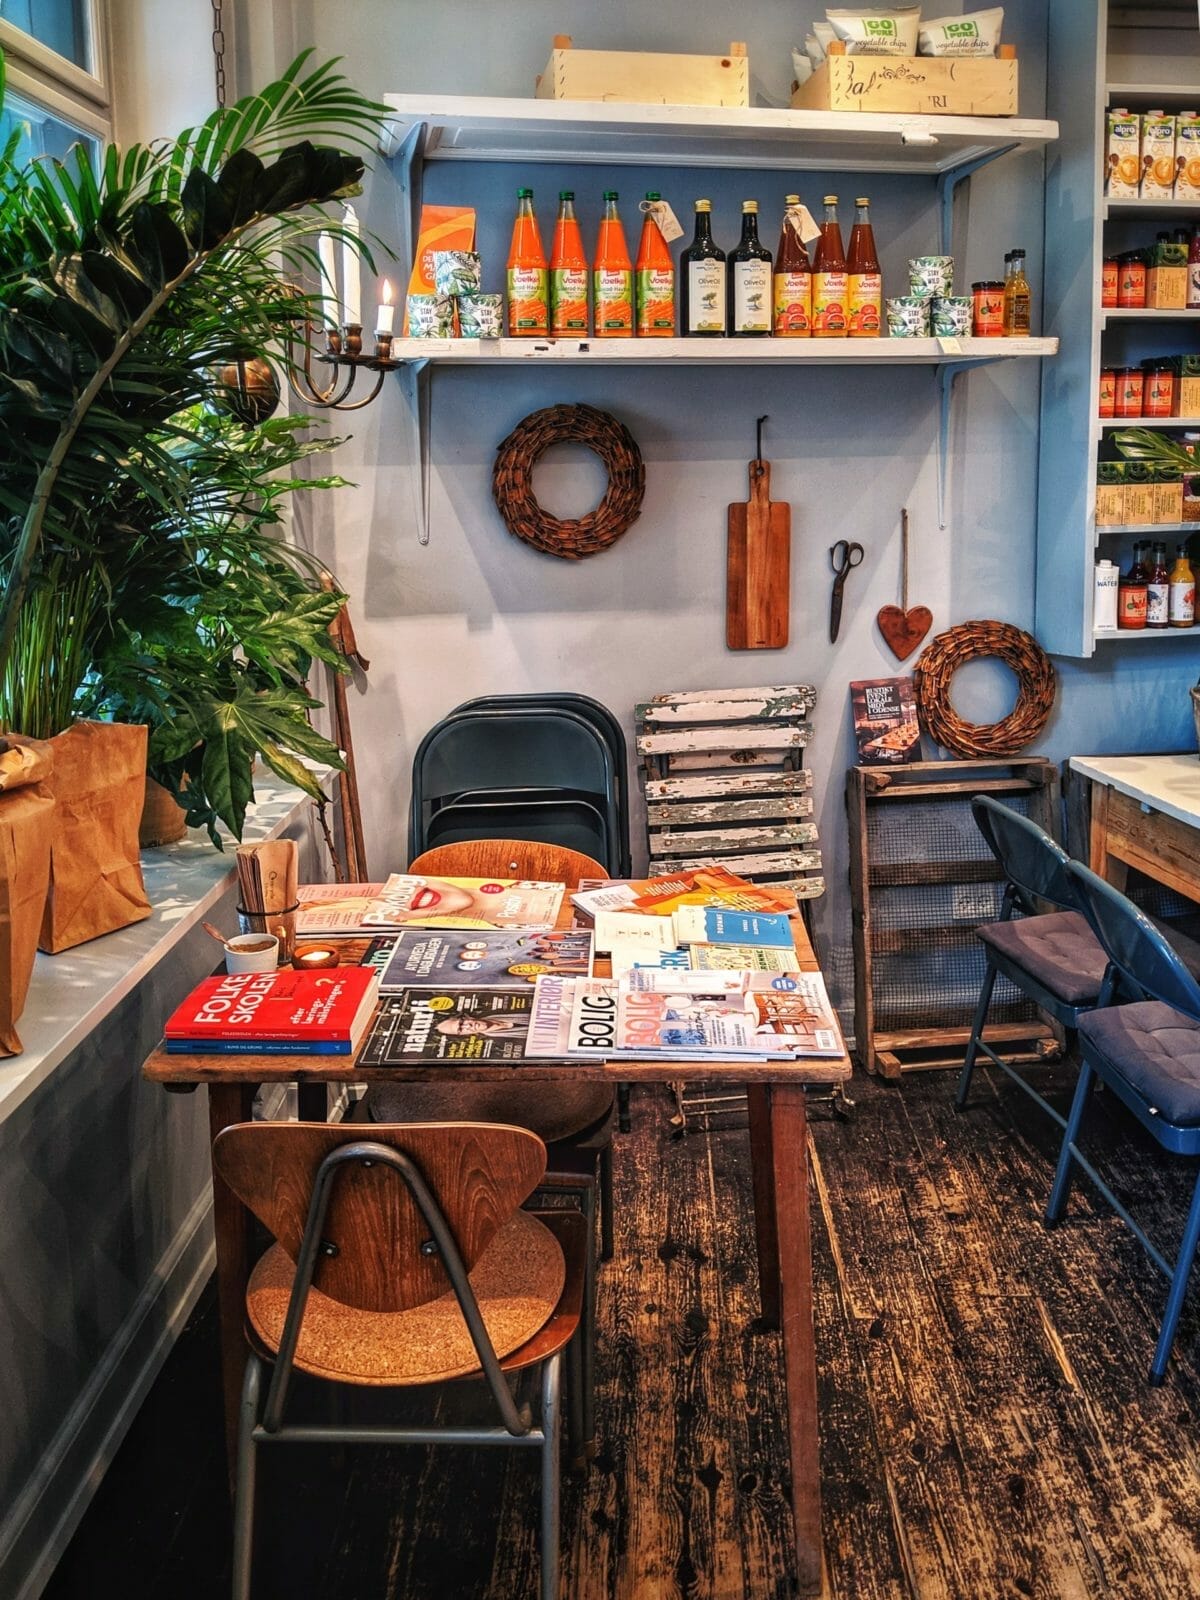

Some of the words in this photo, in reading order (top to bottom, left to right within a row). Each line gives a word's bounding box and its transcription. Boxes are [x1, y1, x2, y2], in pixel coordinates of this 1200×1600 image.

[867, 20, 892, 29] GO
[947, 22, 973, 32] GO
[855, 37, 887, 49] vegetable
[890, 38, 907, 49] chips
[936, 39, 969, 49] vegetable
[970, 38, 989, 48] chips
[1115, 125, 1135, 134] alpro
[1150, 126, 1170, 135] alpro
[481, 317, 494, 325] WILD
[872, 706, 900, 714] ODENSE
[405, 942, 427, 971] AYURVEDA
[194, 975, 253, 1023] FOLKE
[228, 972, 281, 1024] SKOLEN
[535, 978, 563, 1030] INTERIØR
[289, 1008, 302, 1024] efter
[578, 996, 616, 1047] BOLIG
[624, 993, 663, 1046] BOLIG
